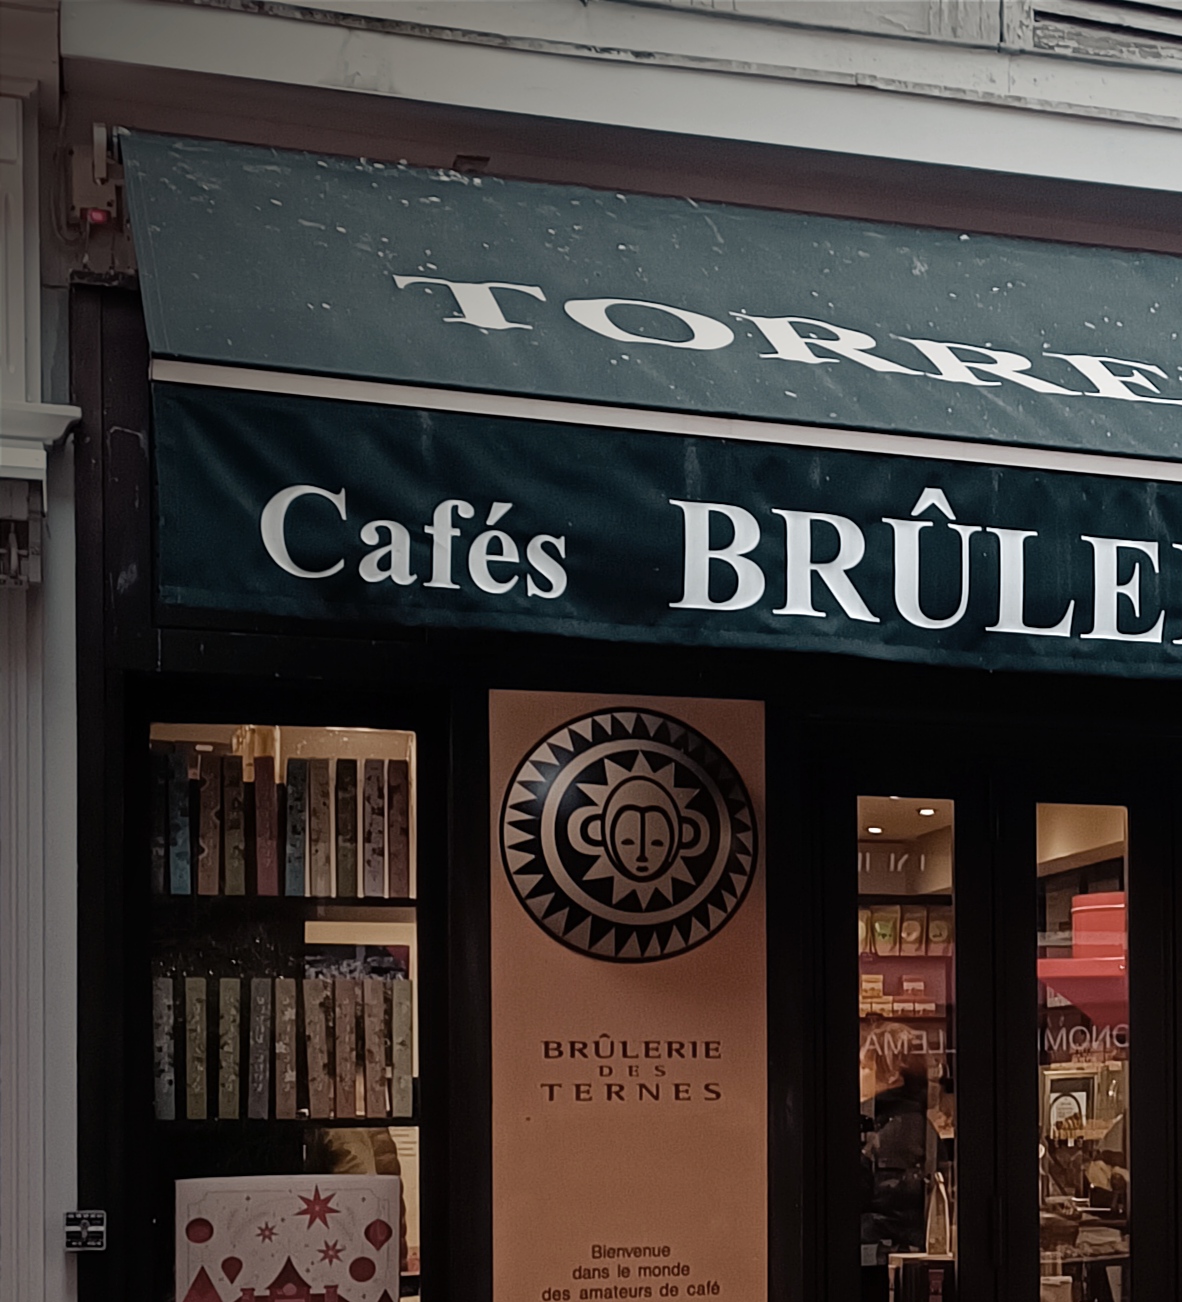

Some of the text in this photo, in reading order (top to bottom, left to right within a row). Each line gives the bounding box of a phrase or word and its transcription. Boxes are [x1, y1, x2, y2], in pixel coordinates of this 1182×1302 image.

[259, 484, 568, 600] Cafés
[541, 1033, 722, 1060] BRÛLERIE
[599, 1064, 667, 1078] DES
[540, 1082, 723, 1102] TERNES
[591, 1244, 672, 1260] Bienvenue
[572, 1262, 691, 1281] dans le monde
[541, 1279, 721, 1302] des amateurs de café
